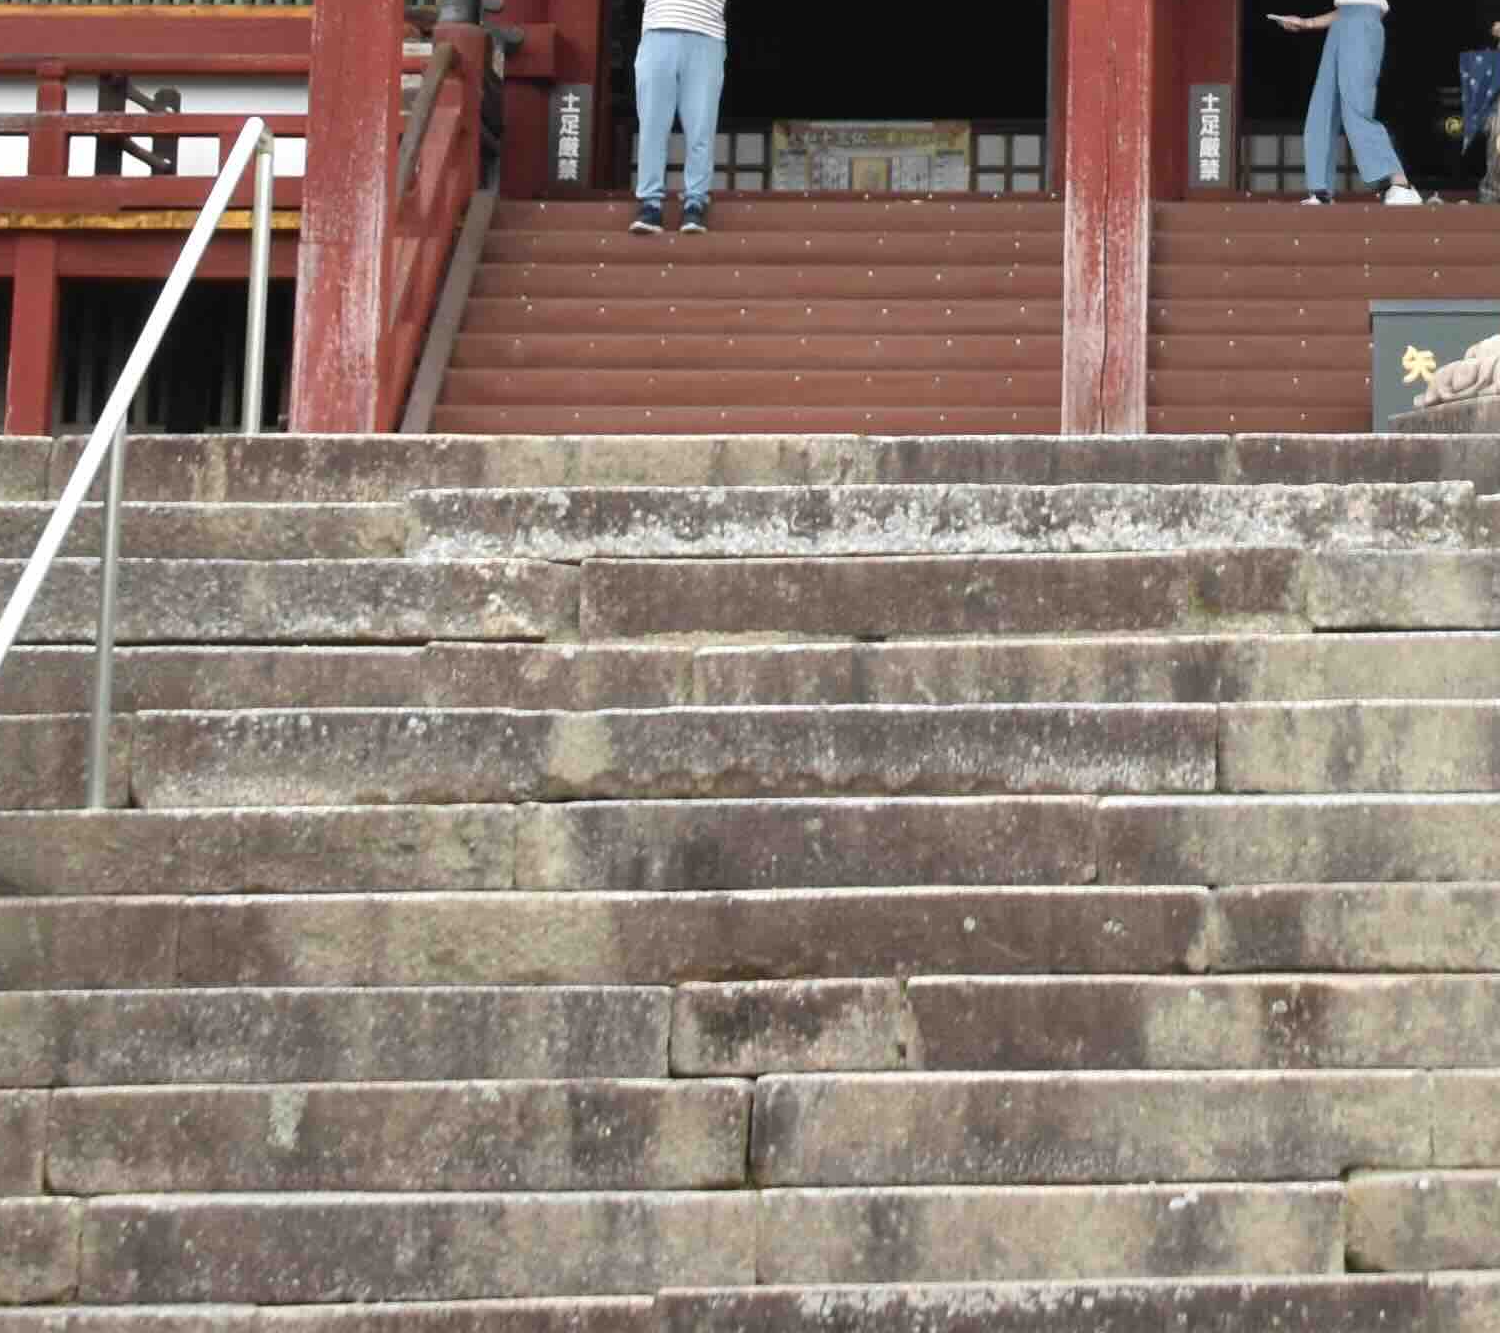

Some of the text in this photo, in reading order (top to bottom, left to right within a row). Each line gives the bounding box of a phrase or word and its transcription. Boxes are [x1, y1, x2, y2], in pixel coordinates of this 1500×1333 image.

[557, 92, 581, 182] 土足厳禁
[1199, 92, 1221, 182] 土足厳禁
[1401, 344, 1438, 390] 矢
